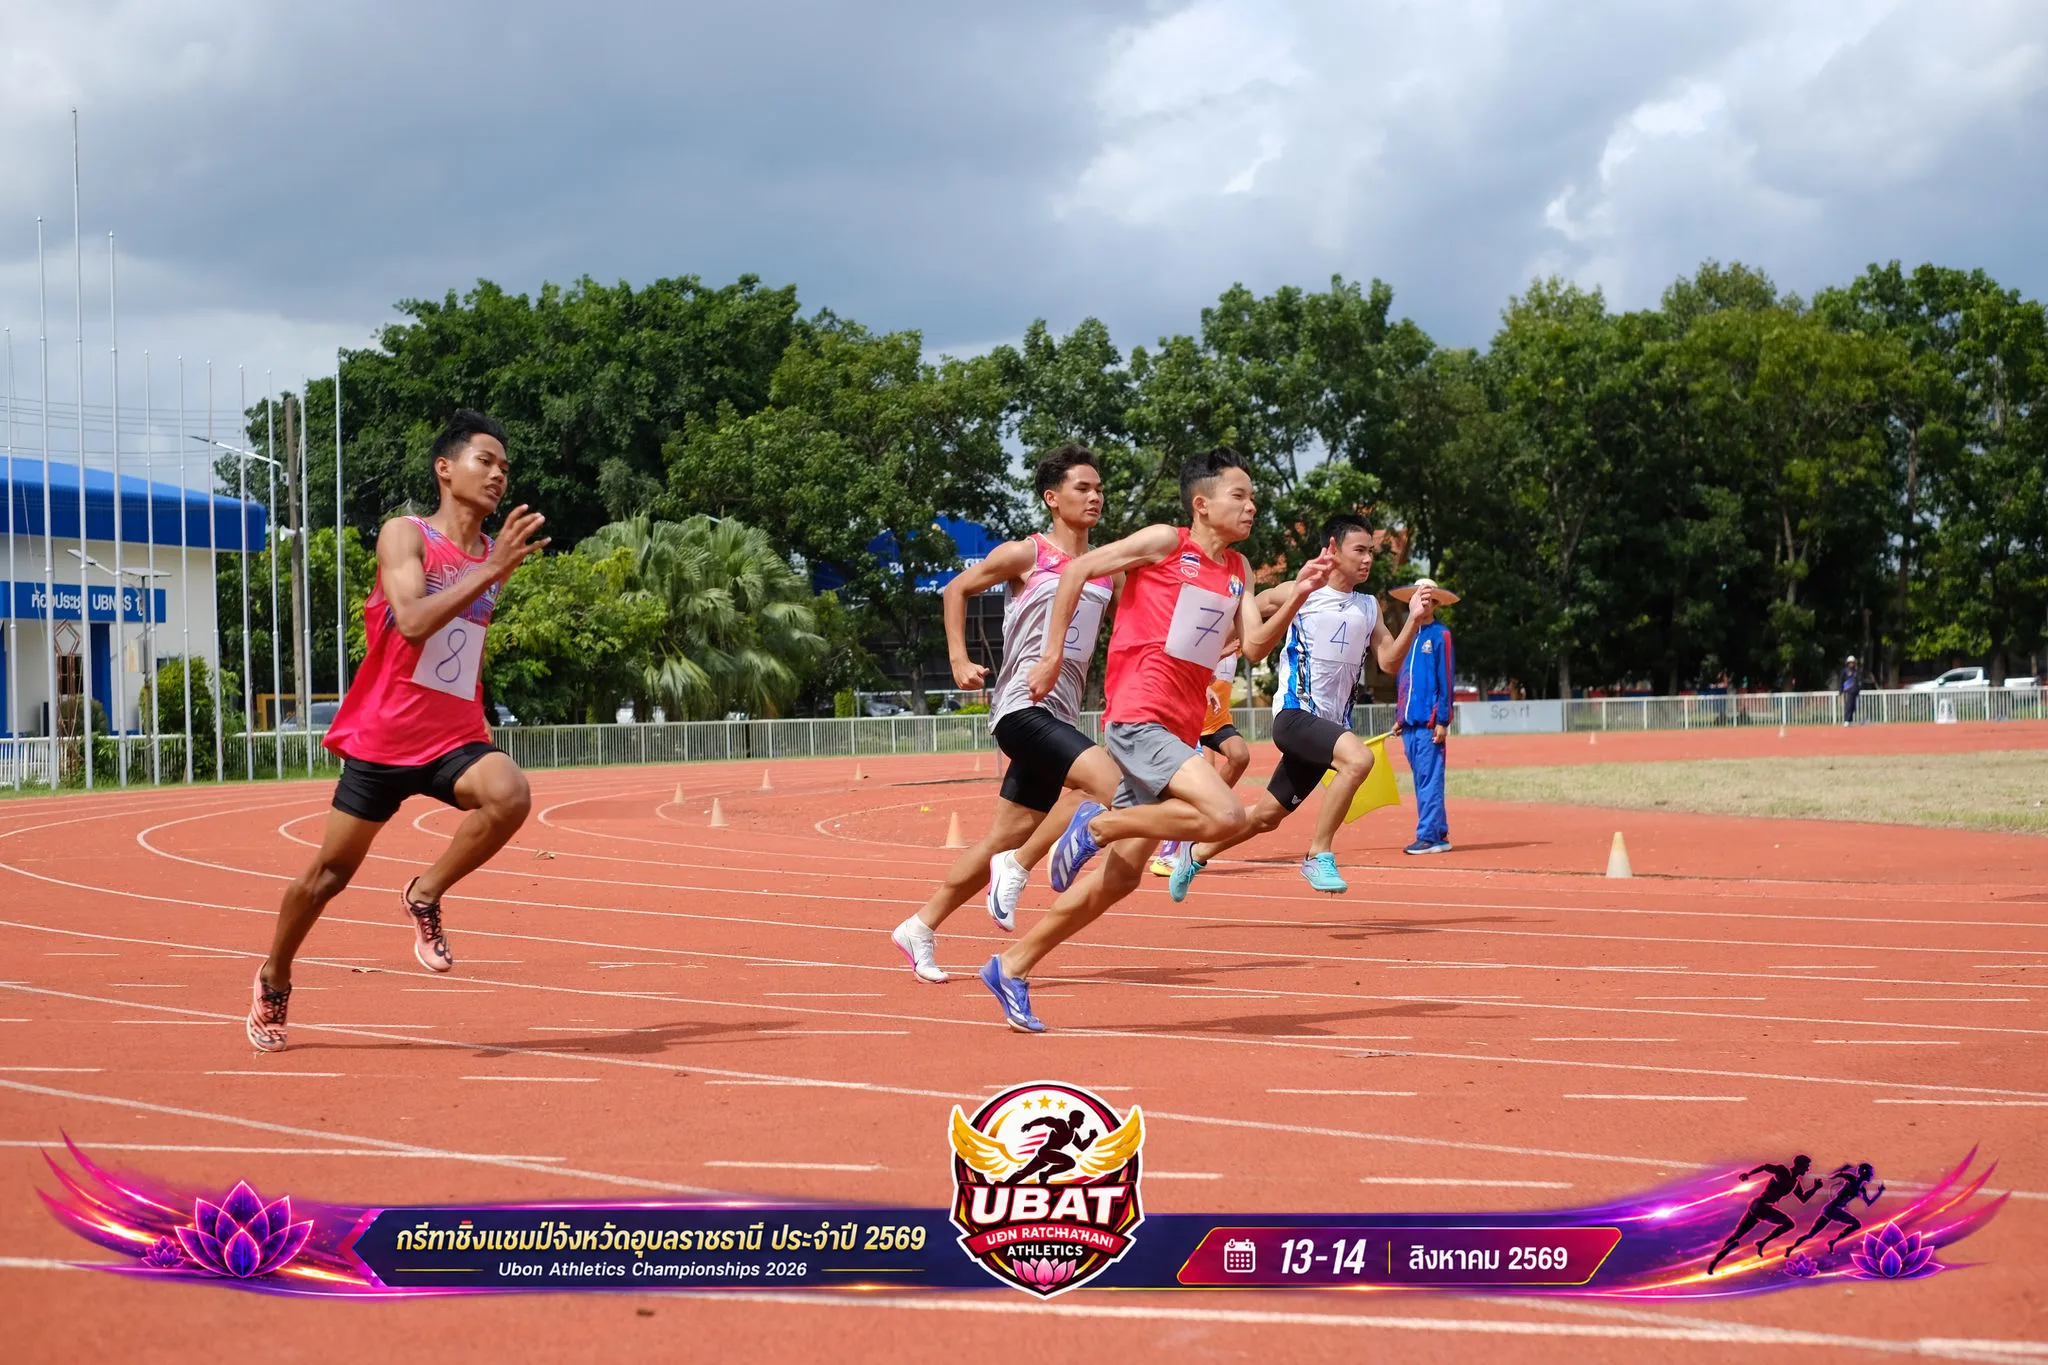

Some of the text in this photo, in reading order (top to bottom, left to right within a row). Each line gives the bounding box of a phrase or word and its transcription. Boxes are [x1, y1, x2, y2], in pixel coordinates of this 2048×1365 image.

[1196, 607, 1225, 648] 7
[1329, 620, 1350, 654] 4
[435, 628, 467, 683] 8
